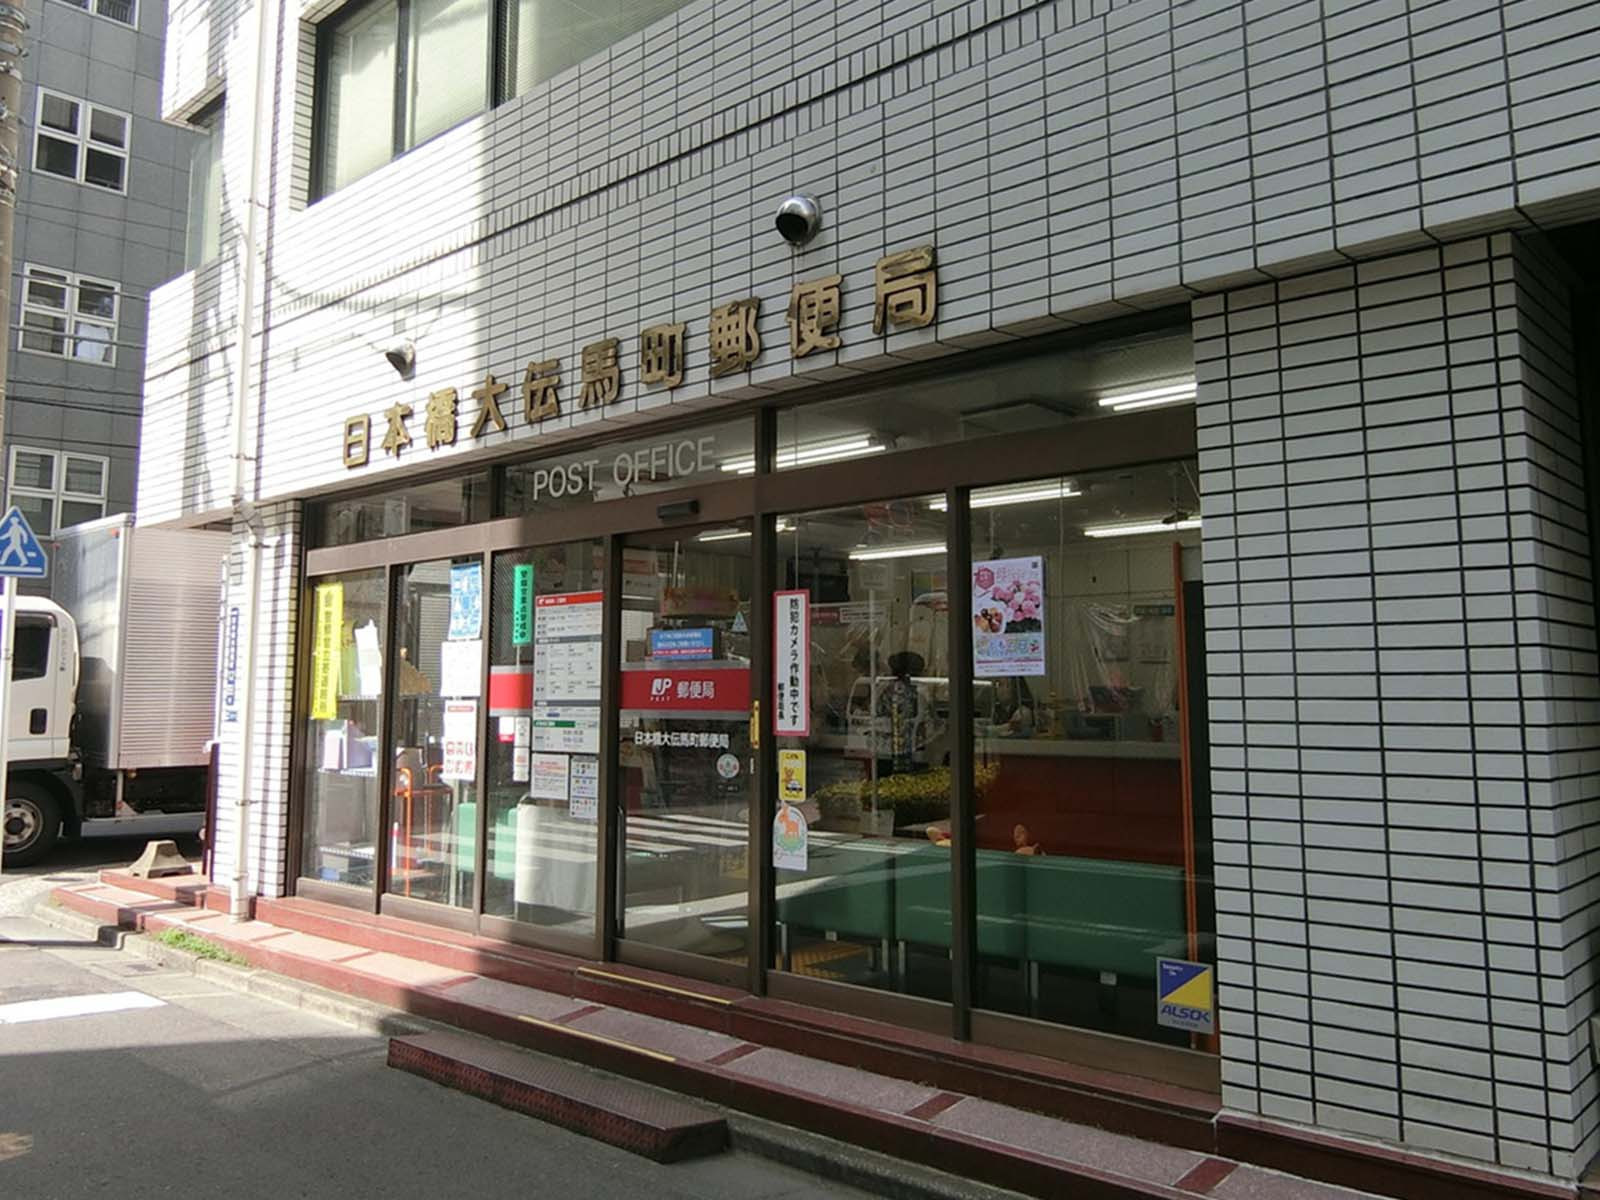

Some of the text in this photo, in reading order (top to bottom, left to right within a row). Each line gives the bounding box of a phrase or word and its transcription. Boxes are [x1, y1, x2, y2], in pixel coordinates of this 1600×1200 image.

[342, 245, 938, 468] 日本橋大伝馬町郵便局
[533, 436, 716, 501] POST OFFICE
[789, 597, 800, 726] 防犯カメラ作動中です
[676, 680, 715, 700] 郵便局
[634, 730, 730, 749] 日本橋大伝馬町郵便局
[1161, 1005, 1211, 1023] ALSOK
